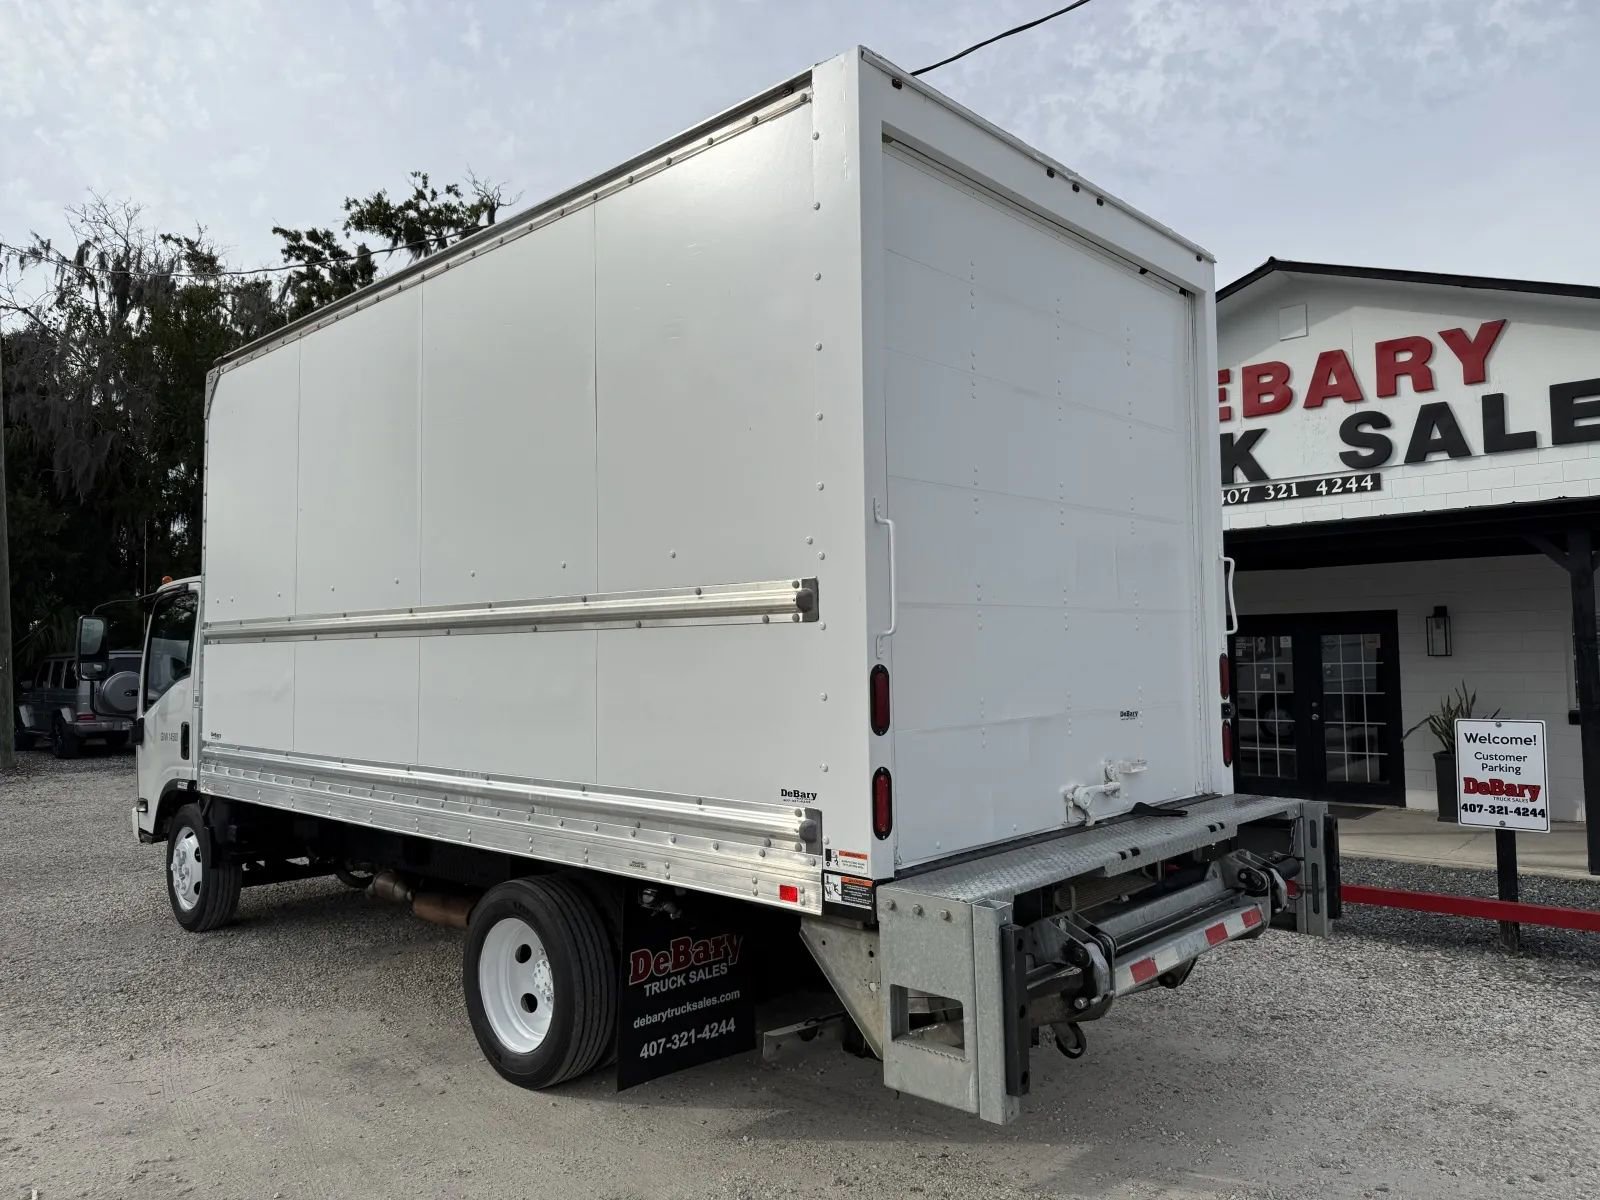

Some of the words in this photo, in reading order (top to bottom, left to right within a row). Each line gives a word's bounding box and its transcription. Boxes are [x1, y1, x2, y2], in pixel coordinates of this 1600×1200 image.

[1264, 482, 1299, 500] 321
[1316, 474, 1374, 496] 4244
[1464, 733, 1537, 746] Welcome!
[1474, 752, 1527, 762] Customer
[1481, 763, 1521, 775] Parking
[780, 789, 817, 800] DeBary
[1463, 777, 1541, 802] DeBary
[1461, 803, 1546, 818] 407-321-4244
[629, 934, 744, 986] DeBary
[644, 973, 686, 997] TRUCK
[688, 962, 728, 984] SALES
[633, 989, 740, 1029] debarytrucksales.com
[639, 1017, 736, 1059] 407-321-4244
